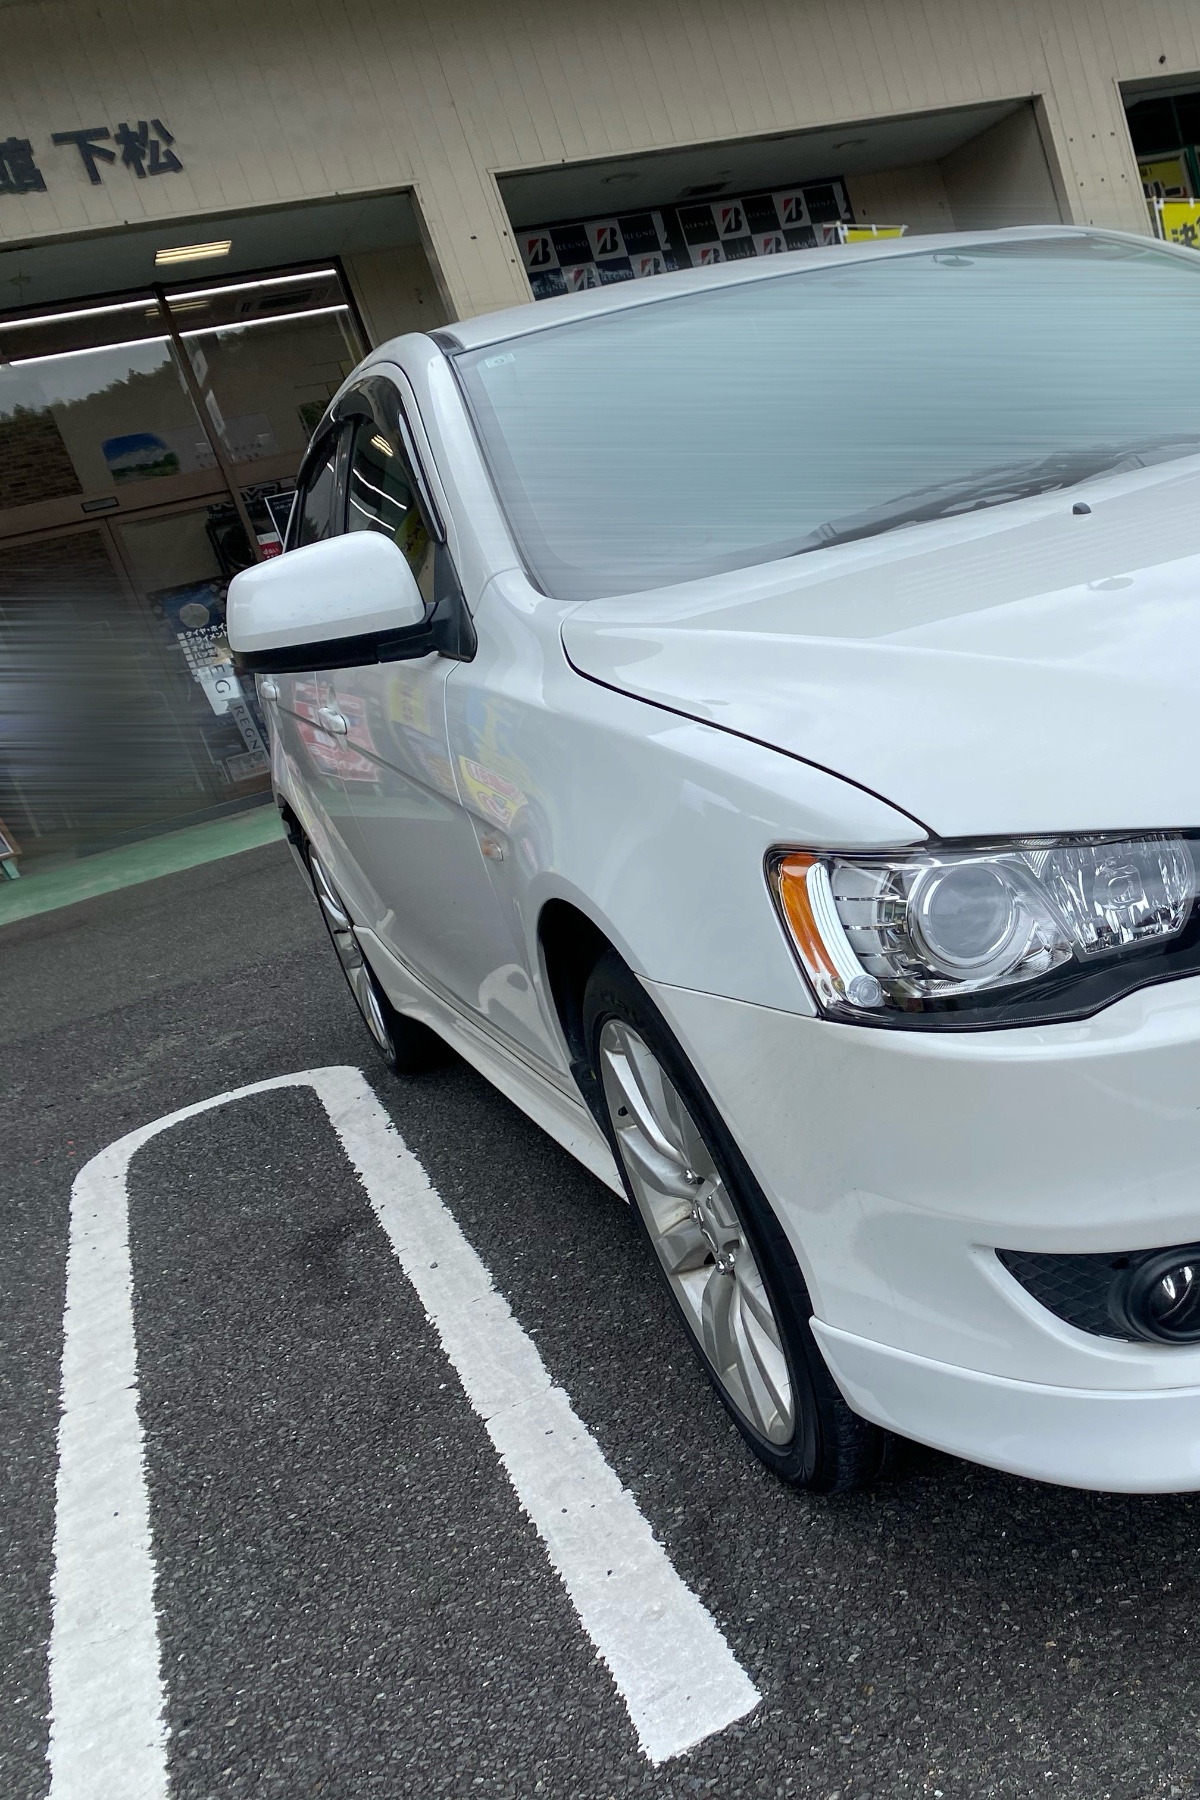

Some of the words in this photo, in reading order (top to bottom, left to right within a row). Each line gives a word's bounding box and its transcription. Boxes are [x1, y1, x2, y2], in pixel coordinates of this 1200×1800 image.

[51, 118, 183, 186] 下松
[555, 240, 589, 252] REGNO
[623, 229, 656, 241] REGNO
[185, 622, 227, 638] タイヤ・ホイ
[234, 705, 265, 759] REGN
